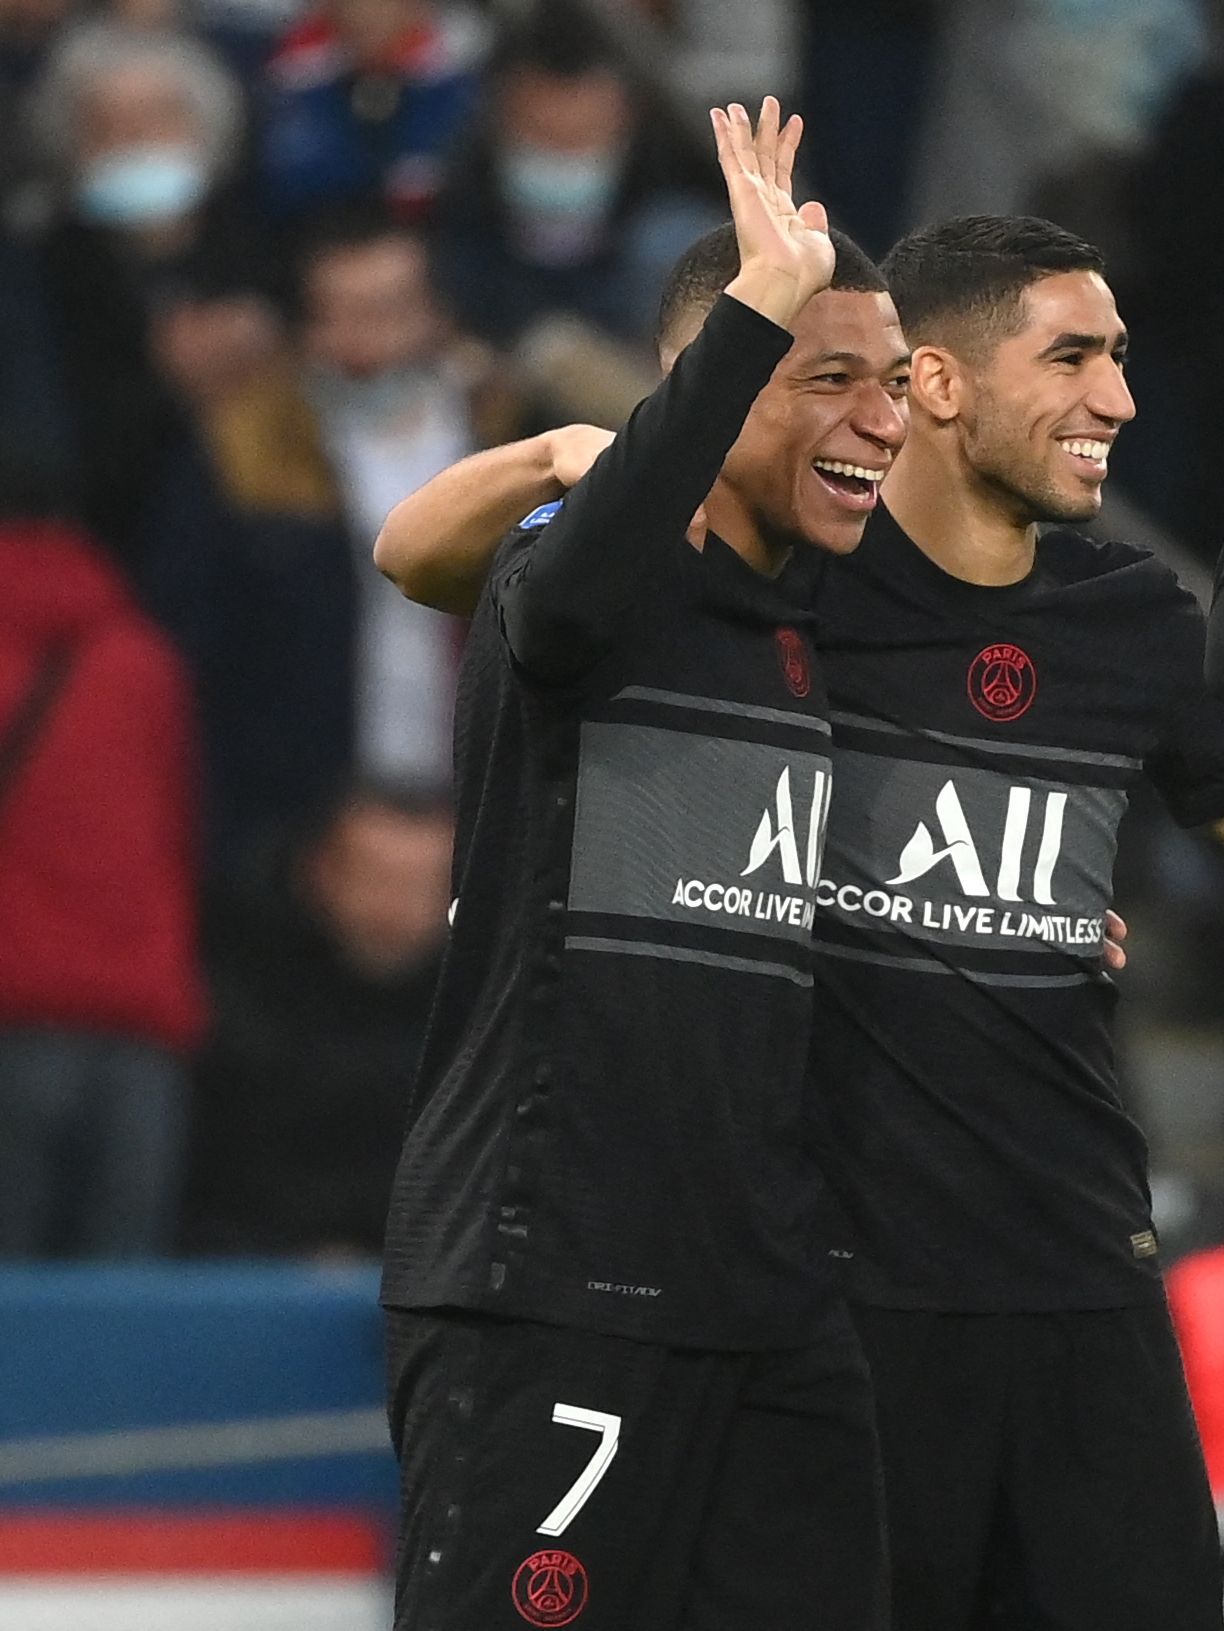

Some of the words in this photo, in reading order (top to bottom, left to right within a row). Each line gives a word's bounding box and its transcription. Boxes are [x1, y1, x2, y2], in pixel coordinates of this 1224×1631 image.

[981, 647, 1027, 670] PARIS
[671, 878, 753, 917] ACCOR
[754, 891, 804, 926] LIVE
[815, 879, 914, 923] CCOR
[922, 901, 995, 933] LIVE
[1000, 910, 1103, 944] LIMITLESS
[536, 1402, 622, 1537] 7
[527, 1553, 579, 1575] PARIS
